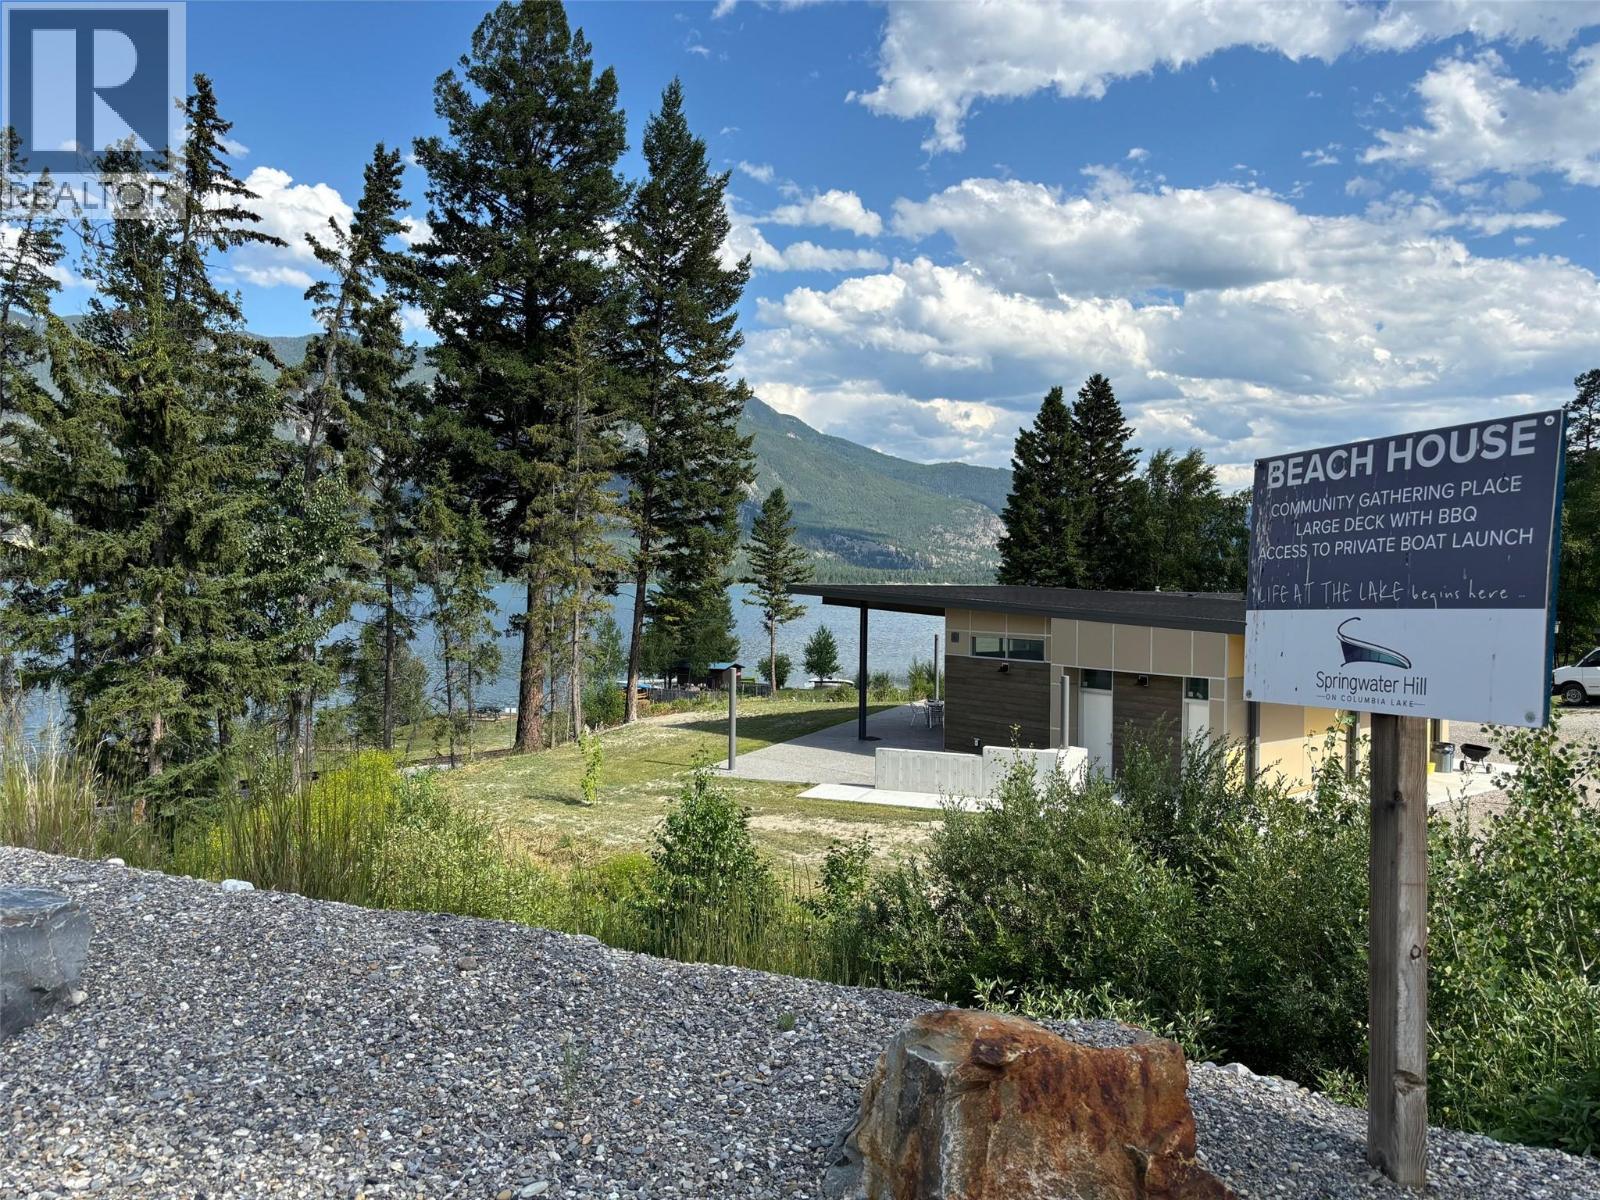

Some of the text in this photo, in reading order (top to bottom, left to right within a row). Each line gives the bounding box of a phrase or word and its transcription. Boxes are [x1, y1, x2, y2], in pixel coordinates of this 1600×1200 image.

[1267, 419, 1538, 489] BEACH HOUSE
[1271, 475, 1523, 517] COMMUNITY GATHERING PLACE
[1296, 506, 1478, 536] LARGE DECK WITH BBQ
[1259, 527, 1534, 560] ACCESS TO PRIVATE BOAT LAUNCH
[1294, 580, 1315, 604] AT
[1320, 580, 1352, 603] THE
[1359, 580, 1404, 603] LAKE
[1412, 583, 1460, 609] begins
[1316, 671, 1427, 696] Springwater Hill
[1325, 693, 1414, 708] ON COLUMBIA LAKE
